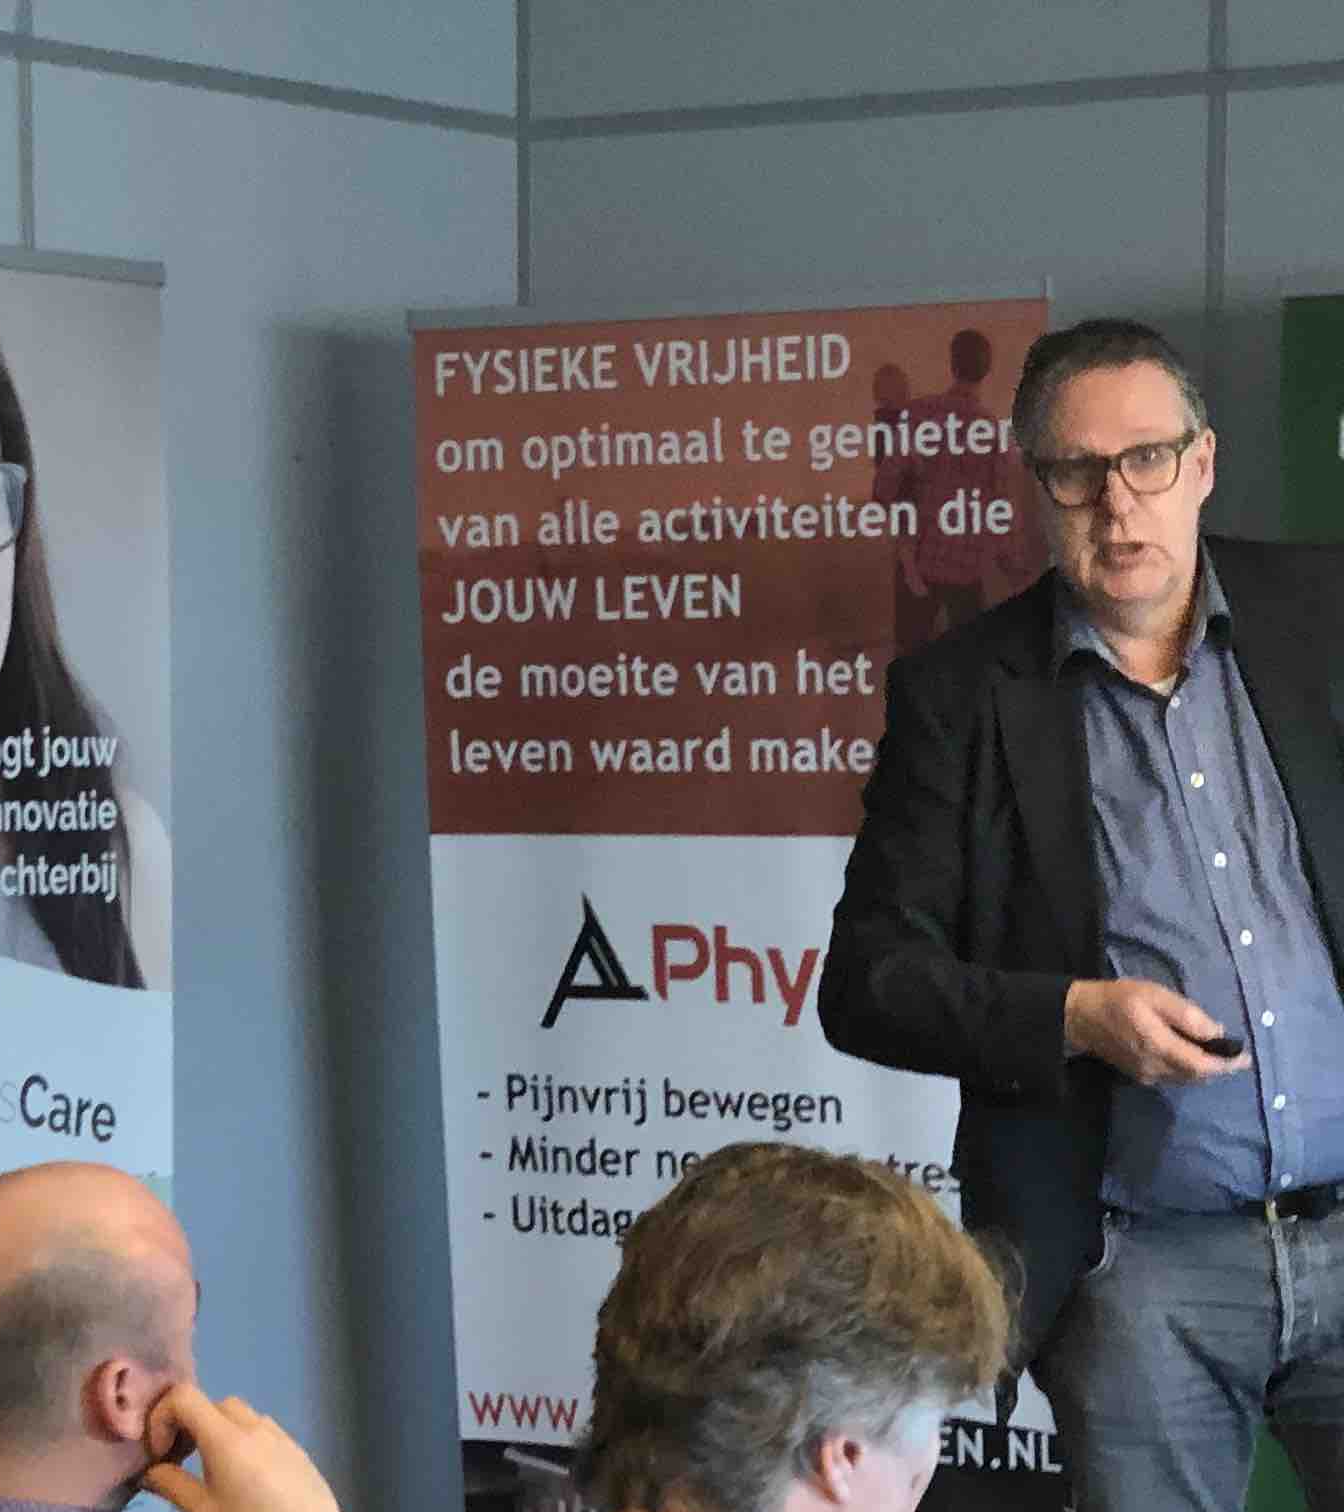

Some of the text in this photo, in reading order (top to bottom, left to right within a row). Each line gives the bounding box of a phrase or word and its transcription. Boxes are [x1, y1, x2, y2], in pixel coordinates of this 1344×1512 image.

[435, 333, 851, 396] FYSIEKE VRIJHEID
[437, 436, 503, 472] om
[523, 418, 723, 478] optimaal
[743, 423, 791, 461] te
[439, 489, 1014, 547] van alle activiteiten die
[442, 574, 742, 624] JOUW LEVEN
[446, 647, 874, 698] de moeite van het
[40, 727, 118, 778] jouw
[450, 728, 573, 774] leven
[590, 727, 732, 772] waard
[507, 1073, 648, 1127] Pijnvrij
[664, 1078, 843, 1132] bewegen
[508, 1135, 641, 1178] Minder
